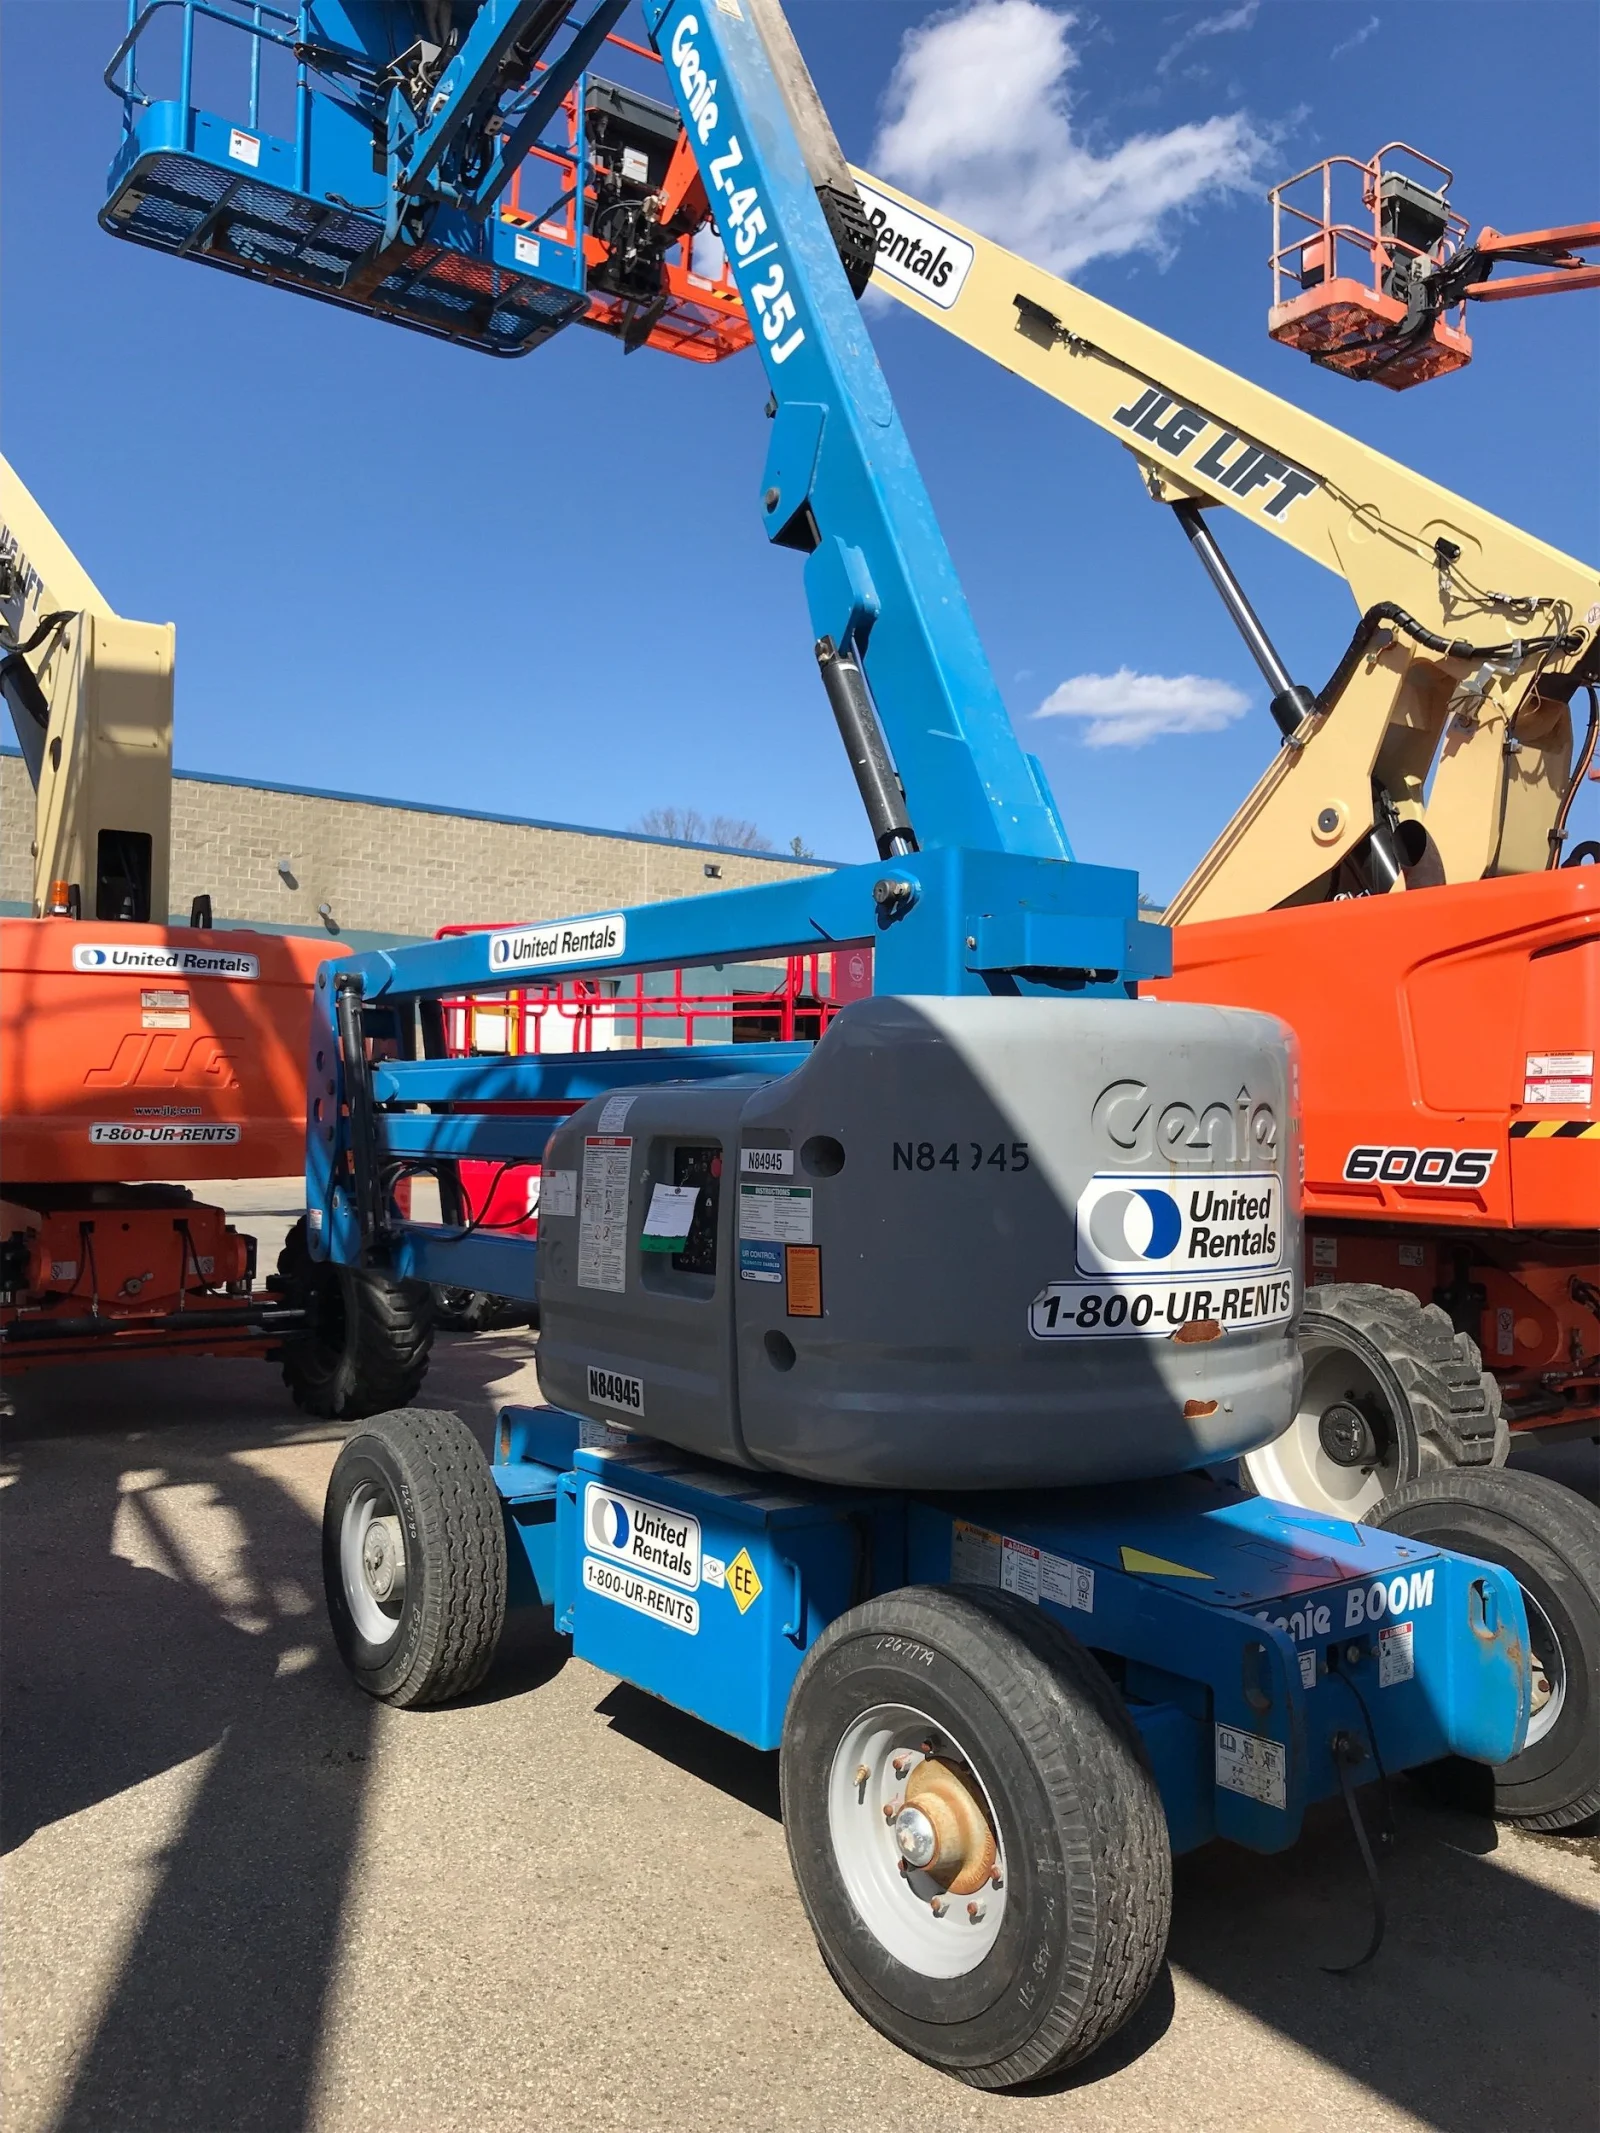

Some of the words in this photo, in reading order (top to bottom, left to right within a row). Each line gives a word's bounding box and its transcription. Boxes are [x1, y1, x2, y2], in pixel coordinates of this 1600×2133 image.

[672, 15, 718, 145] Genie
[869, 207, 953, 287] Rentals
[1112, 388, 1208, 457] JLG
[1193, 432, 1318, 517] LIFT
[512, 933, 559, 960] United
[562, 925, 617, 953] Rentals
[112, 951, 178, 967] United
[183, 953, 250, 972] Rentals
[83, 1033, 244, 1089] JLG
[135, 1106, 201, 1117] www.jlg.com
[1091, 1079, 1276, 1164] Genie
[748, 1152, 783, 1170] N84945
[1345, 1148, 1493, 1185] 600S
[755, 1187, 791, 1196] INSTRUCTIONS
[1190, 1189, 1272, 1223] United
[750, 1250, 776, 1260] CONTROL
[1188, 1224, 1276, 1258] Rentals
[1043, 1280, 1290, 1328] 1-800-UR-RENTS
[590, 1369, 640, 1408] N84945
[634, 1510, 688, 1548] United
[632, 1535, 692, 1576] Rentals
[1012, 1543, 1036, 1557] DANGER
[588, 1565, 694, 1624] 1-800-UR-RENTS
[735, 1565, 752, 1595] EE
[1345, 1569, 1435, 1628] BOOM
